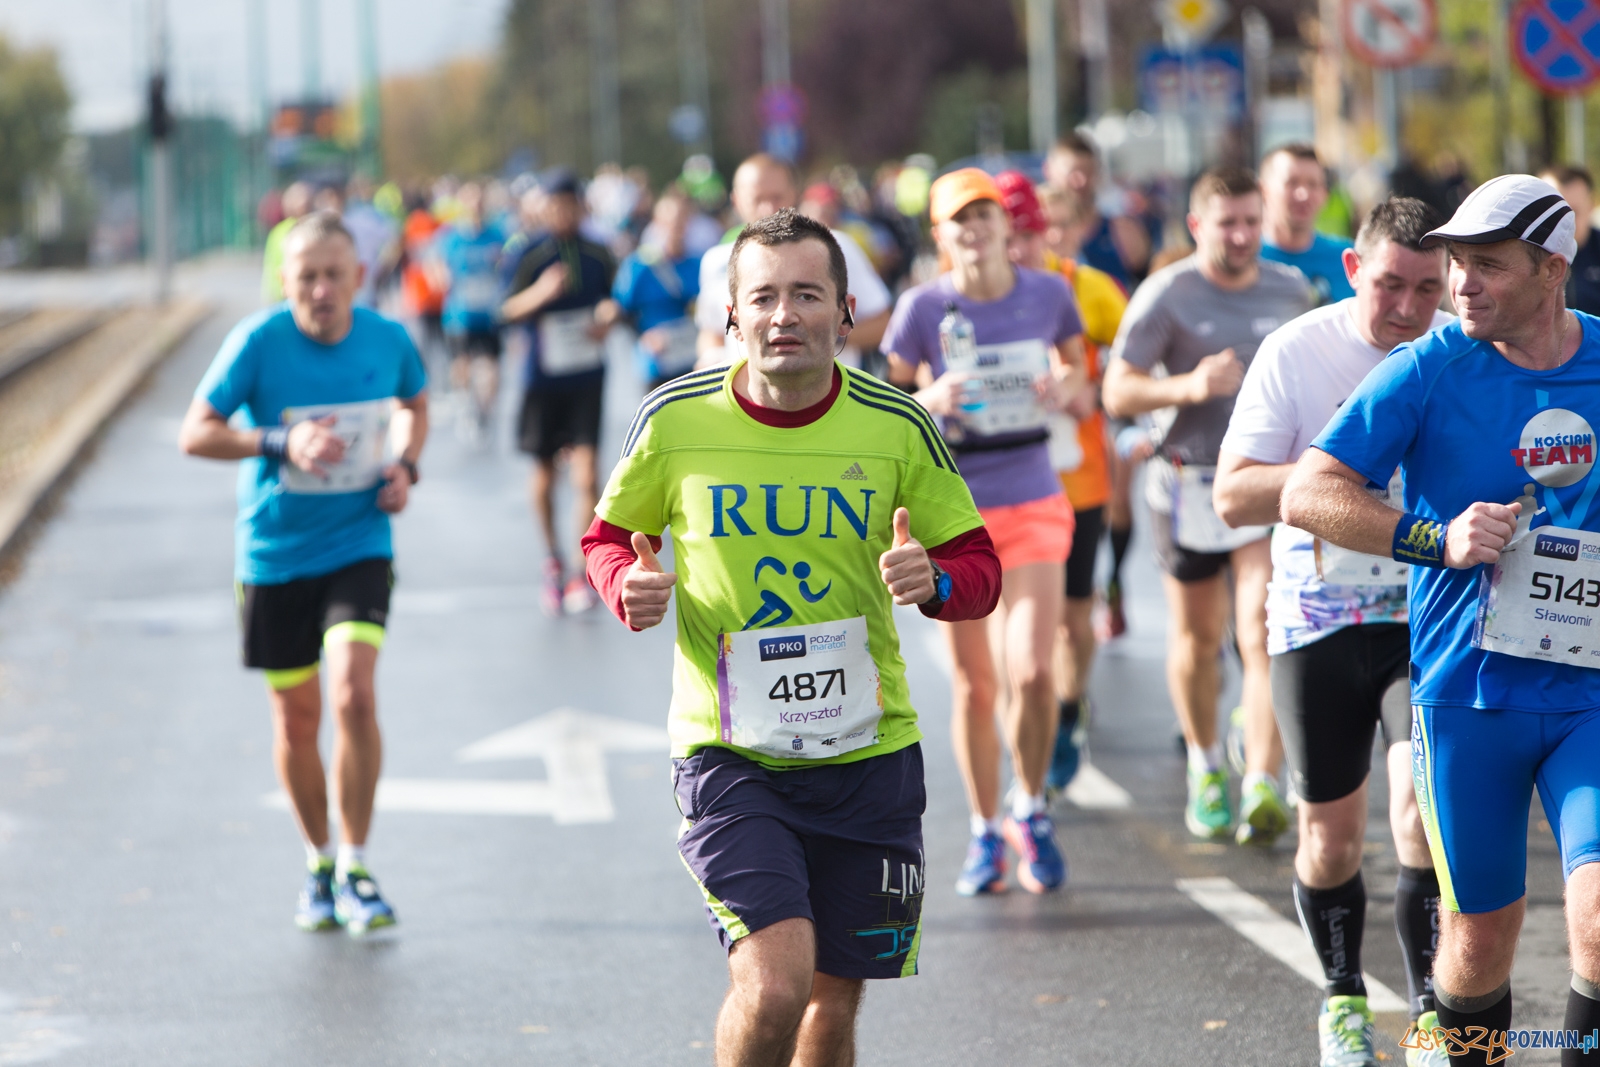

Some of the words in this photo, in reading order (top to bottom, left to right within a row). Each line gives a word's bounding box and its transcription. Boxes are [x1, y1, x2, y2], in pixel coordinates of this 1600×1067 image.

[1534, 432, 1592, 448] KOŚCIAN
[1510, 444, 1593, 467] TEAM
[840, 473, 868, 481] adidas
[707, 484, 877, 541] RUN
[1529, 571, 1600, 608] 5143
[1534, 607, 1593, 627] Sławomir
[810, 641, 847, 652] maraton
[1567, 645, 1583, 655] 4F
[768, 668, 847, 703] 4871
[779, 704, 843, 724] Krzysztof
[820, 736, 838, 746] 4F
